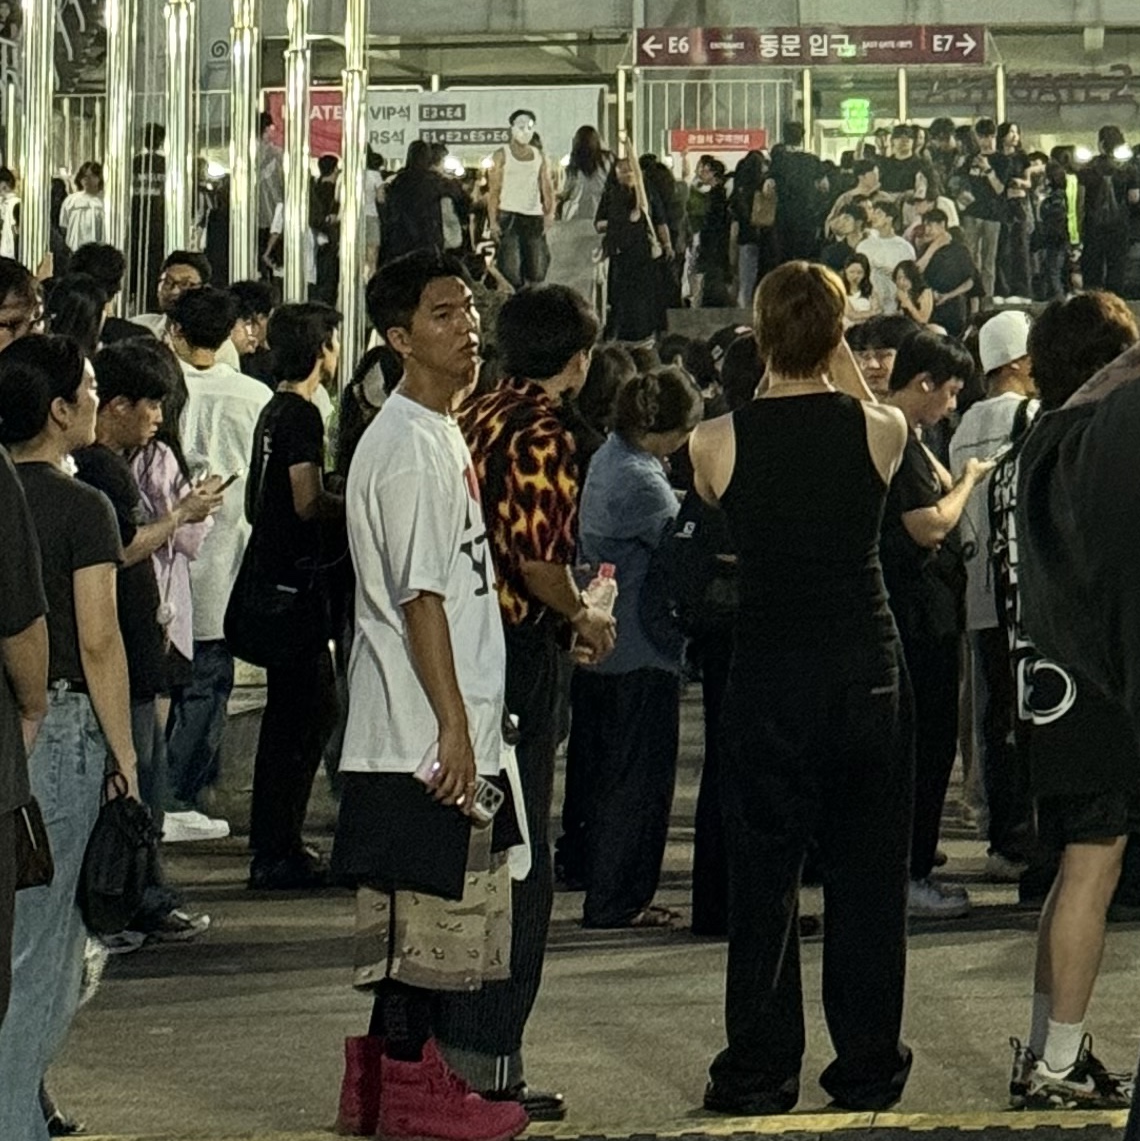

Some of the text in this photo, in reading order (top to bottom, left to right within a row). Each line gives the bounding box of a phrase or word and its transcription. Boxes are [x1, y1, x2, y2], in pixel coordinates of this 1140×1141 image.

[668, 36, 689, 54] E6
[759, 34, 851, 58] 동문 입구
[932, 34, 954, 52] E7
